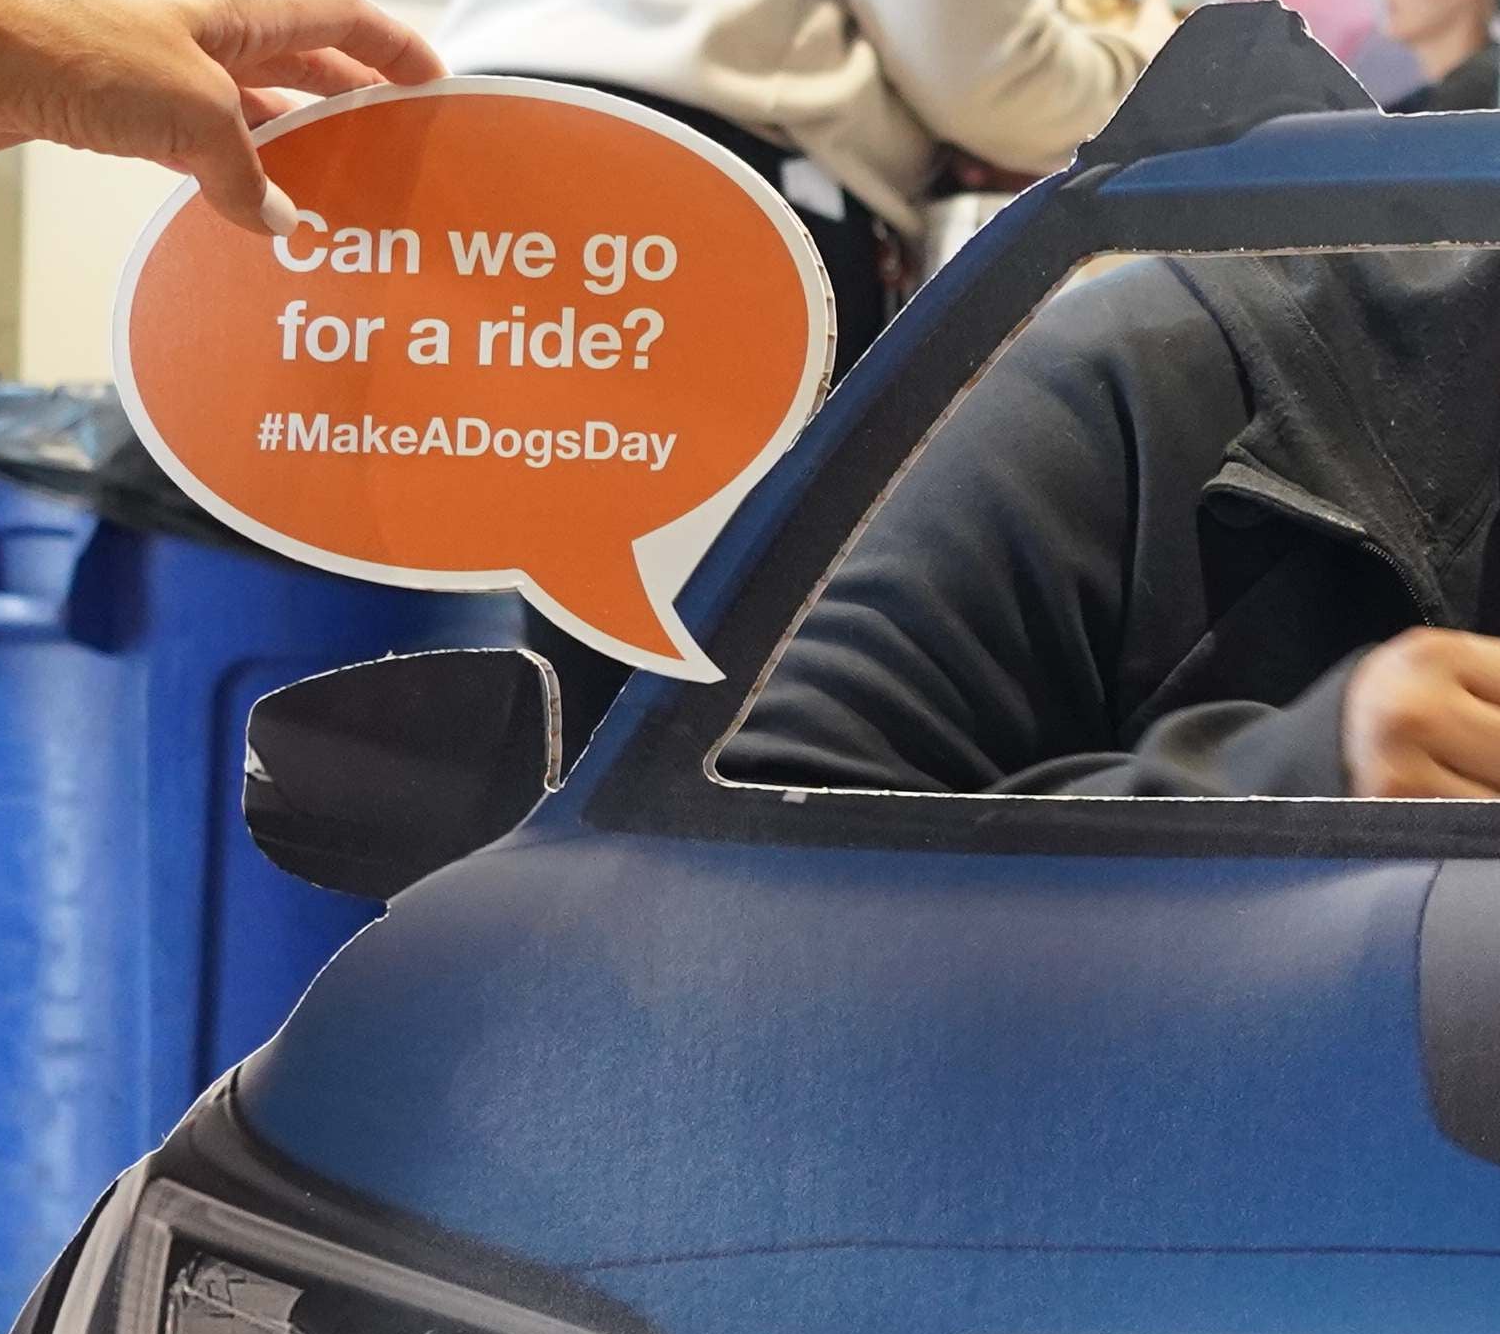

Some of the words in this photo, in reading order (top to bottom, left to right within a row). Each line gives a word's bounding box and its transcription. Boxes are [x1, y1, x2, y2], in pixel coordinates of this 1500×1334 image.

[273, 208, 421, 275] Can
[447, 227, 556, 278] we
[582, 232, 678, 295] go
[277, 299, 385, 363] for
[408, 318, 450, 366] a
[478, 306, 666, 371] ride?
[257, 412, 677, 472] #MakeADogsDay
